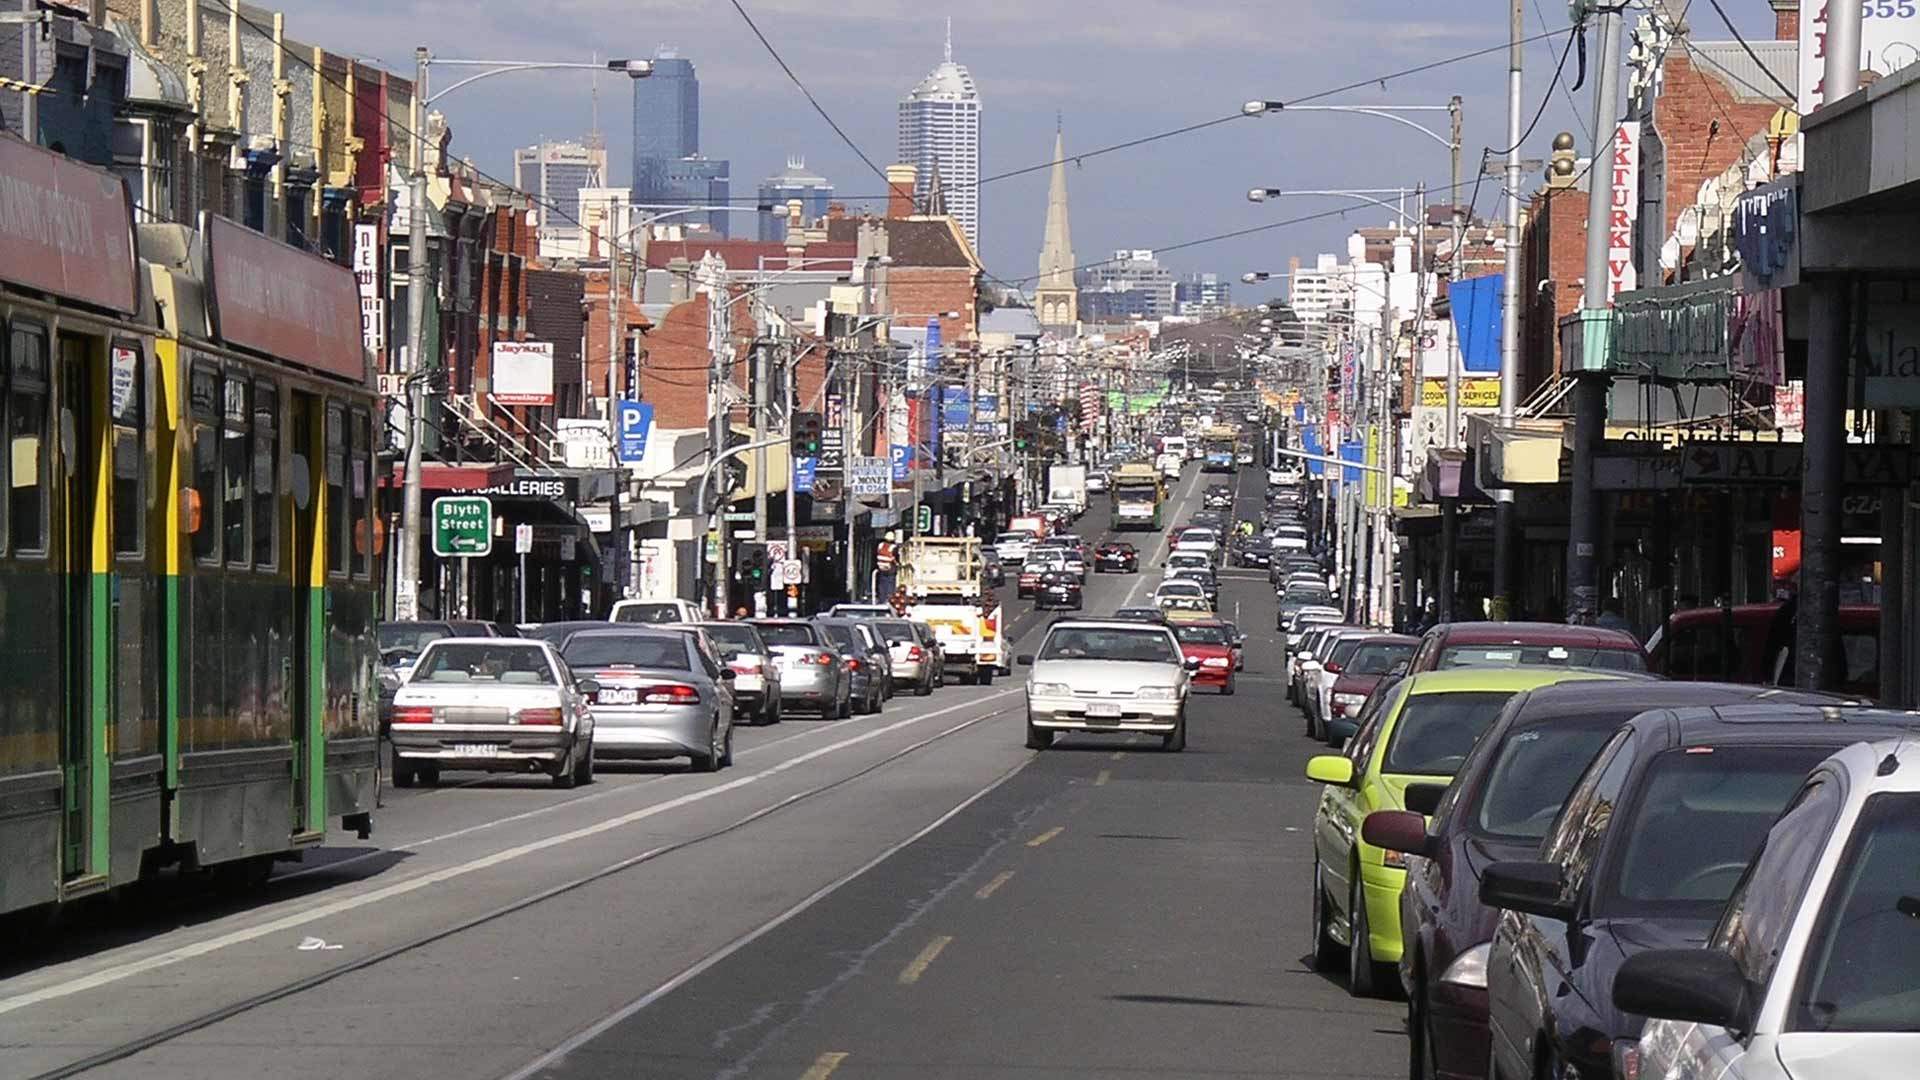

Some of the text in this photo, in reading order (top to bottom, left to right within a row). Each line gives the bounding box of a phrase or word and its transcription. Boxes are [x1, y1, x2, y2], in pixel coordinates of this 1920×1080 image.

[1611, 127, 1632, 249] AKTURK
[497, 394, 546, 403] Jewellery
[623, 410, 641, 432] P
[443, 504, 481, 517] Blyth
[441, 519, 483, 530] Street
